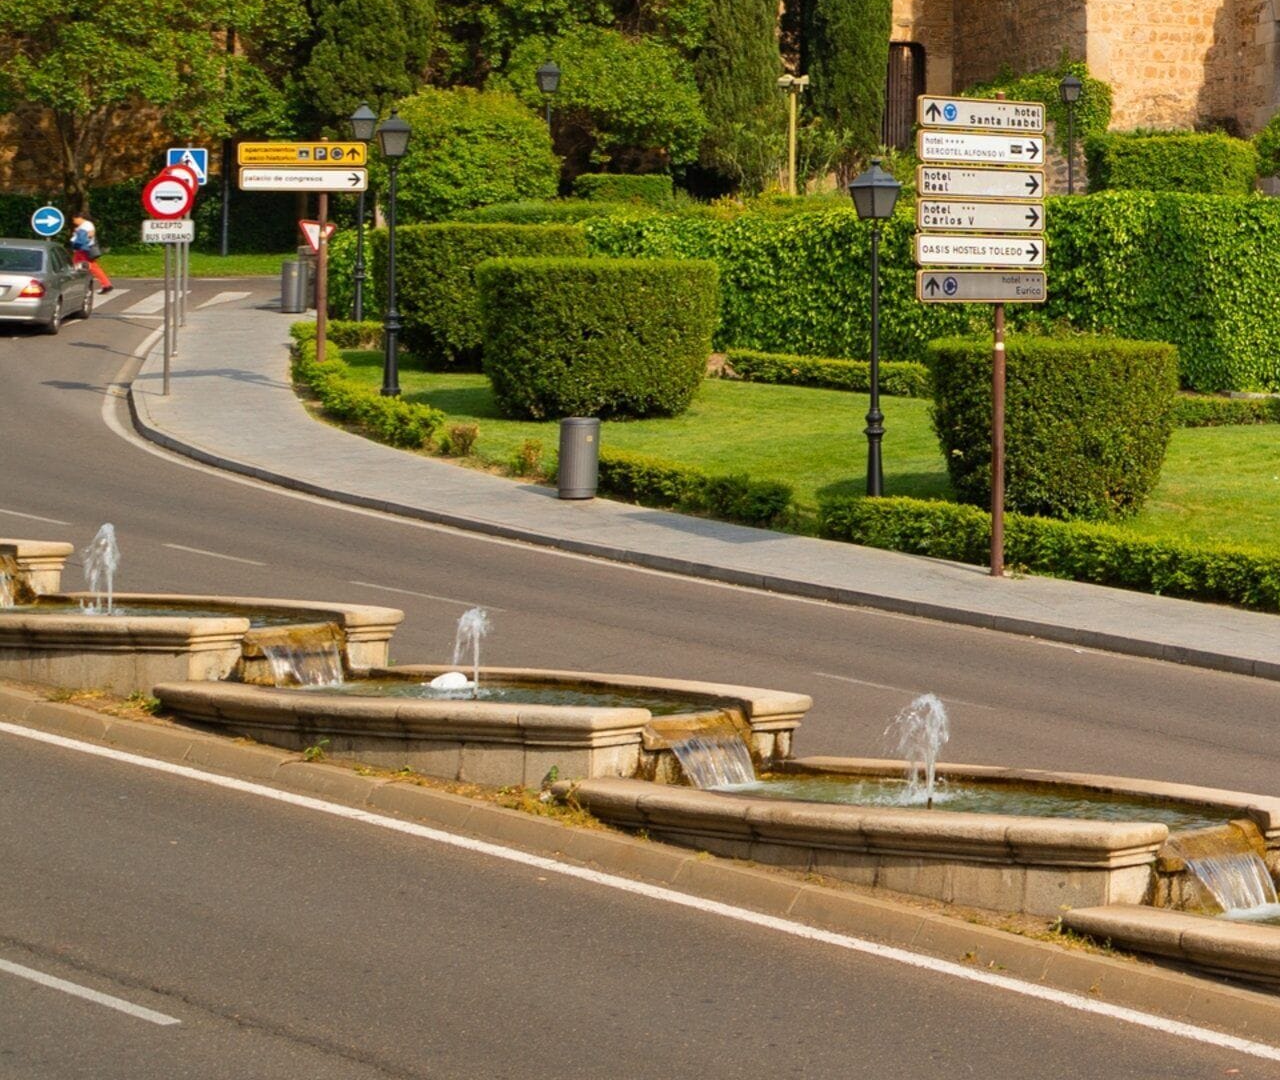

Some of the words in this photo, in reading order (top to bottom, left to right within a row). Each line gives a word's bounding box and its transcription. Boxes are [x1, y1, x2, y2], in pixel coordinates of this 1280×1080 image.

[1014, 107, 1040, 117] hotel
[970, 115, 1001, 126] Santa
[1007, 117, 1040, 128] Isabel
[926, 147, 961, 156] SERCOTEL
[964, 149, 997, 157] ALFONSO
[924, 171, 951, 180] hotel
[924, 181, 948, 191] Real
[923, 206, 951, 214] hotel
[923, 215, 962, 225] Carlos
[968, 217, 975, 225] V
[922, 245, 950, 254] OASIS
[953, 247, 986, 255] HOSTELS
[990, 247, 1022, 256] TOLEDO
[1002, 276, 1021, 284] hotel
[1016, 287, 1041, 295] Eurico
